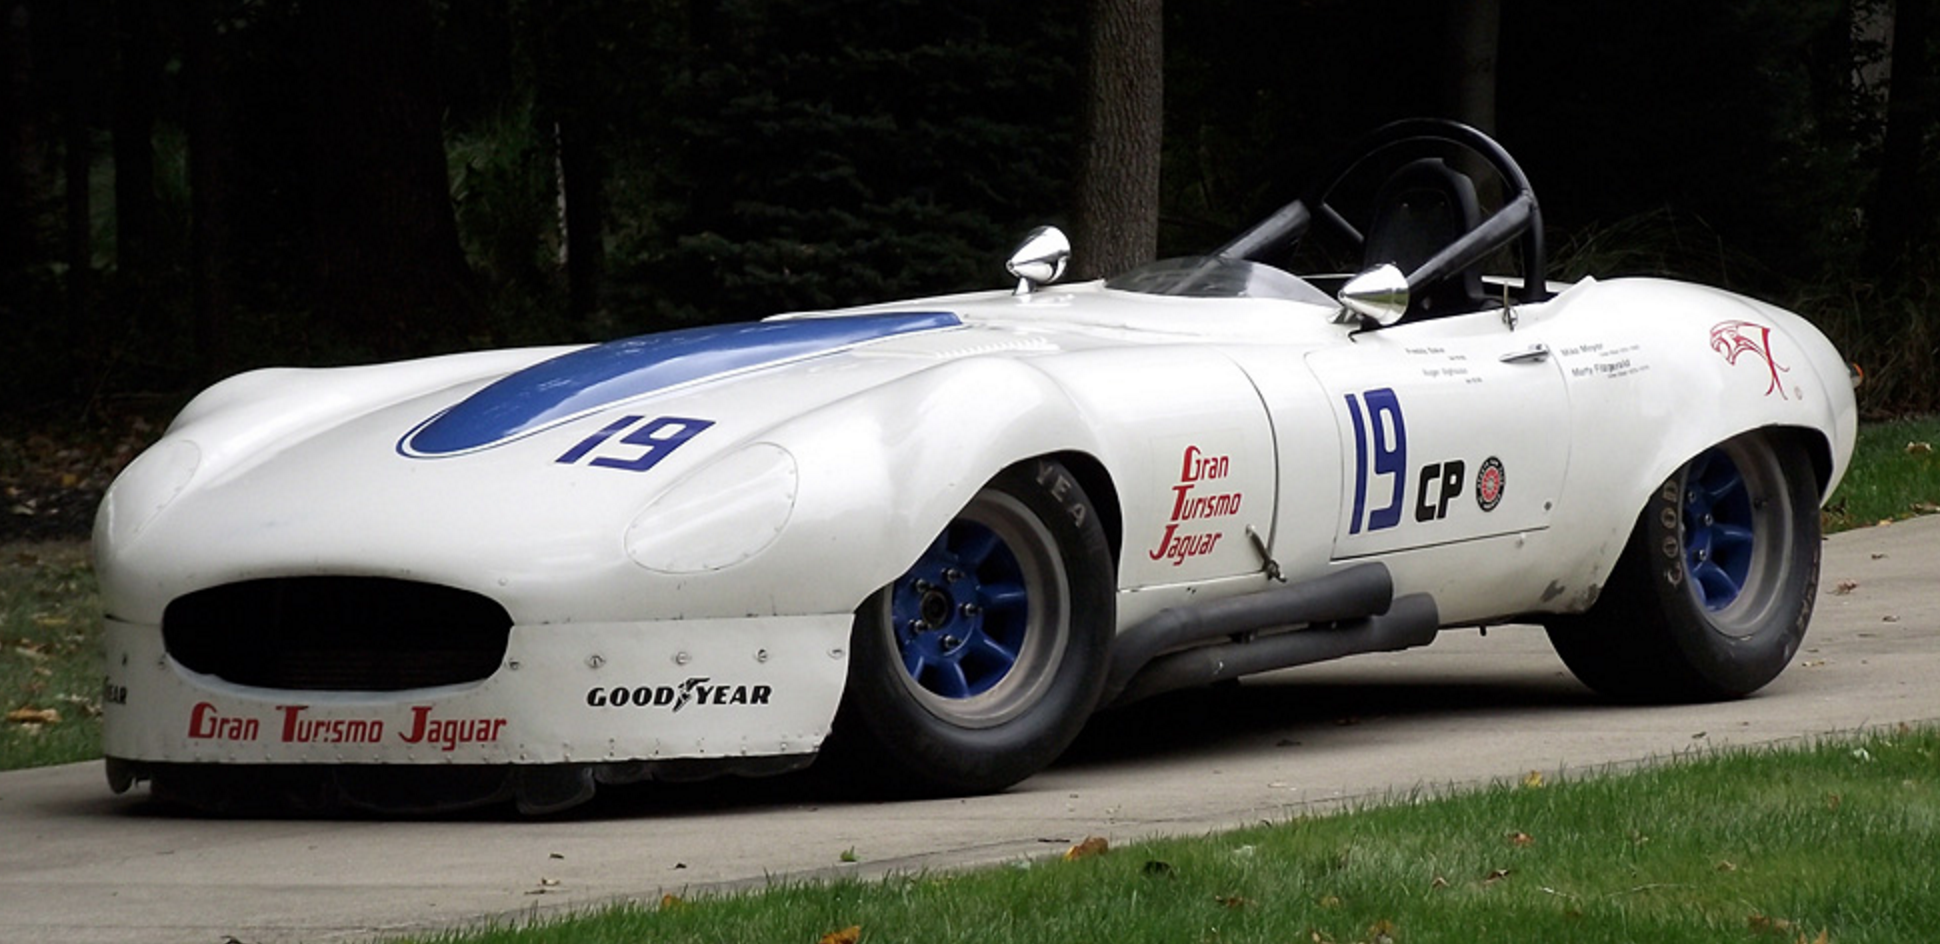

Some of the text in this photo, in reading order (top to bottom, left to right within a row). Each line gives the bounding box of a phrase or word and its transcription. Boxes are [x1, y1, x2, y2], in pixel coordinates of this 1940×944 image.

[555, 415, 717, 472] 19
[1181, 445, 1229, 482] Gran
[1344, 388, 1407, 534] 19
[1415, 460, 1465, 522] CP
[1171, 484, 1242, 521] Turismo
[1149, 524, 1222, 566] Jaguar
[188, 702, 507, 751] Gran Turismo Jaguar
